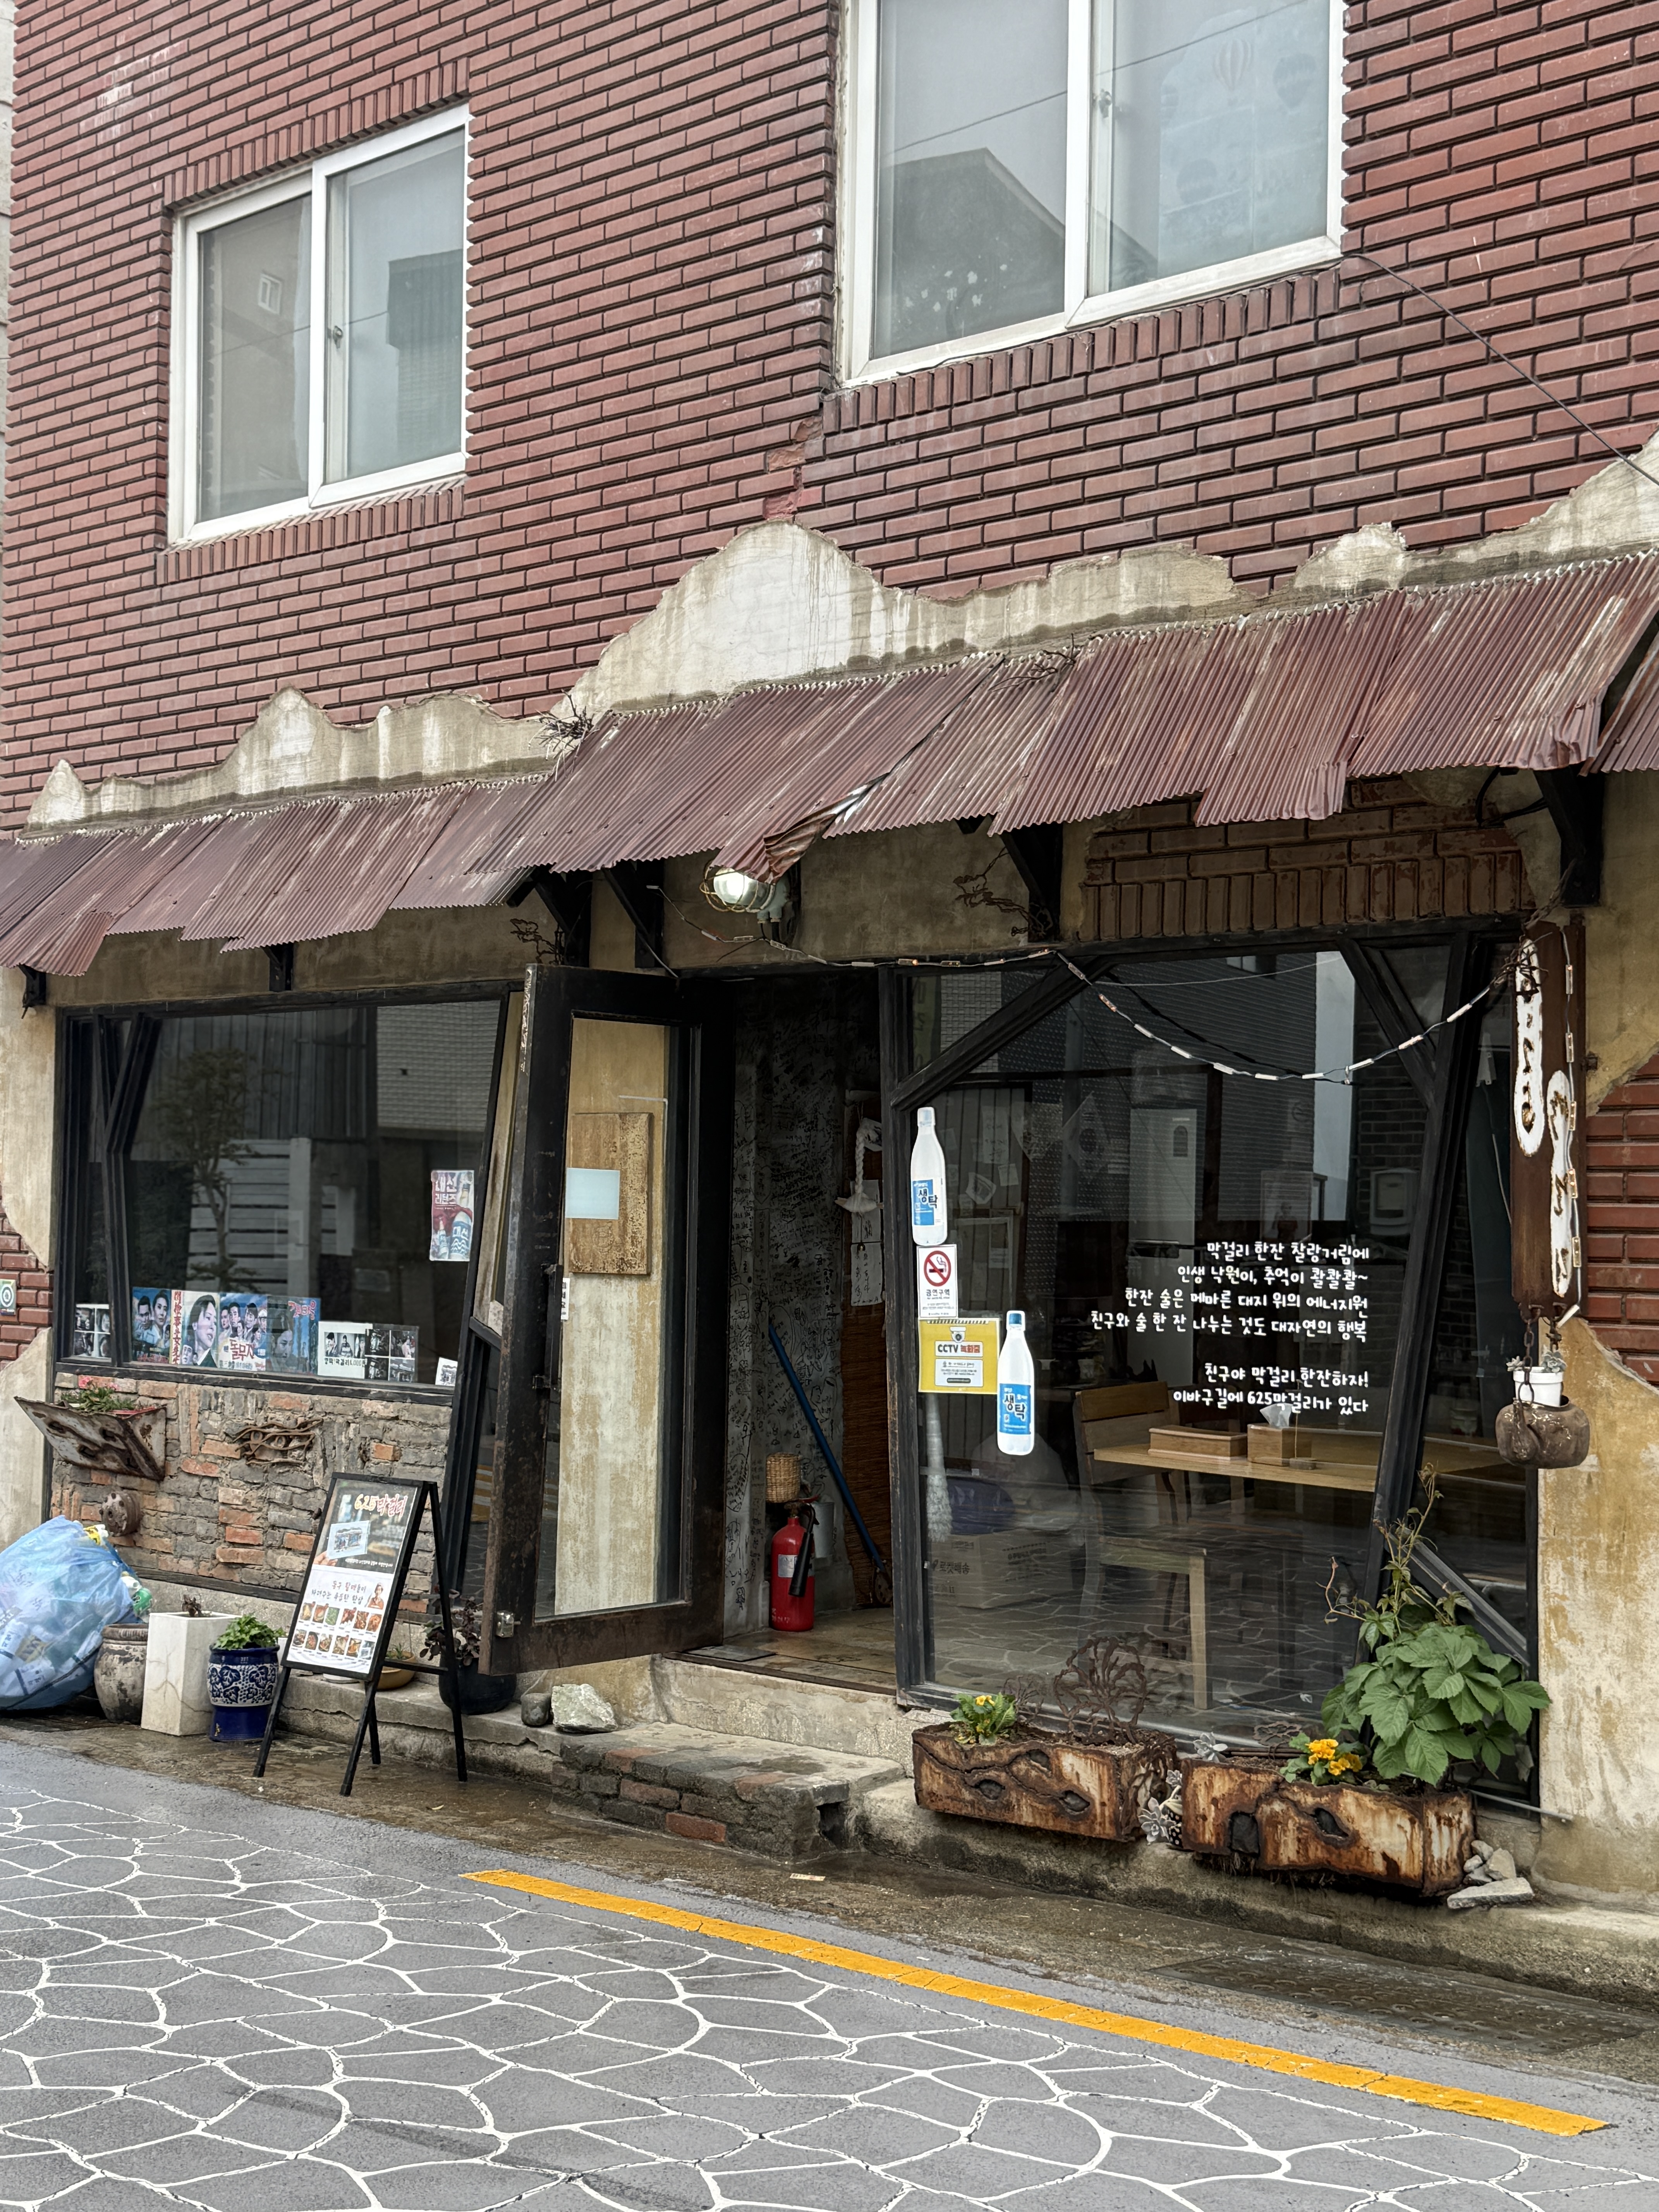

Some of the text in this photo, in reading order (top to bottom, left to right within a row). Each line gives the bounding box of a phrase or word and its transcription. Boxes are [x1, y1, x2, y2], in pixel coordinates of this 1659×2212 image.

[918, 1188, 938, 1209] 생탁
[1207, 1242, 1369, 1265] 막걸리 한잔 찰랑거림에
[1178, 1266, 1205, 1284] 인생
[1211, 1266, 1257, 1285] 낙원이,
[1264, 1266, 1304, 1286] 추억이
[1125, 1288, 1368, 1318] 한잔 술은 메마른 대지 위의 에너지원
[1091, 1311, 1367, 1343] 친구와 술 한 잔 나누는 것도 대자연의 행복
[938, 1344, 958, 1353] CCTV
[1204, 1362, 1369, 1388] 친구야 막걸리 한잔하자!
[1004, 1395, 1025, 1420] 생탁
[1173, 1390, 1369, 1415] 이바구길에 625막걸리가 있다
